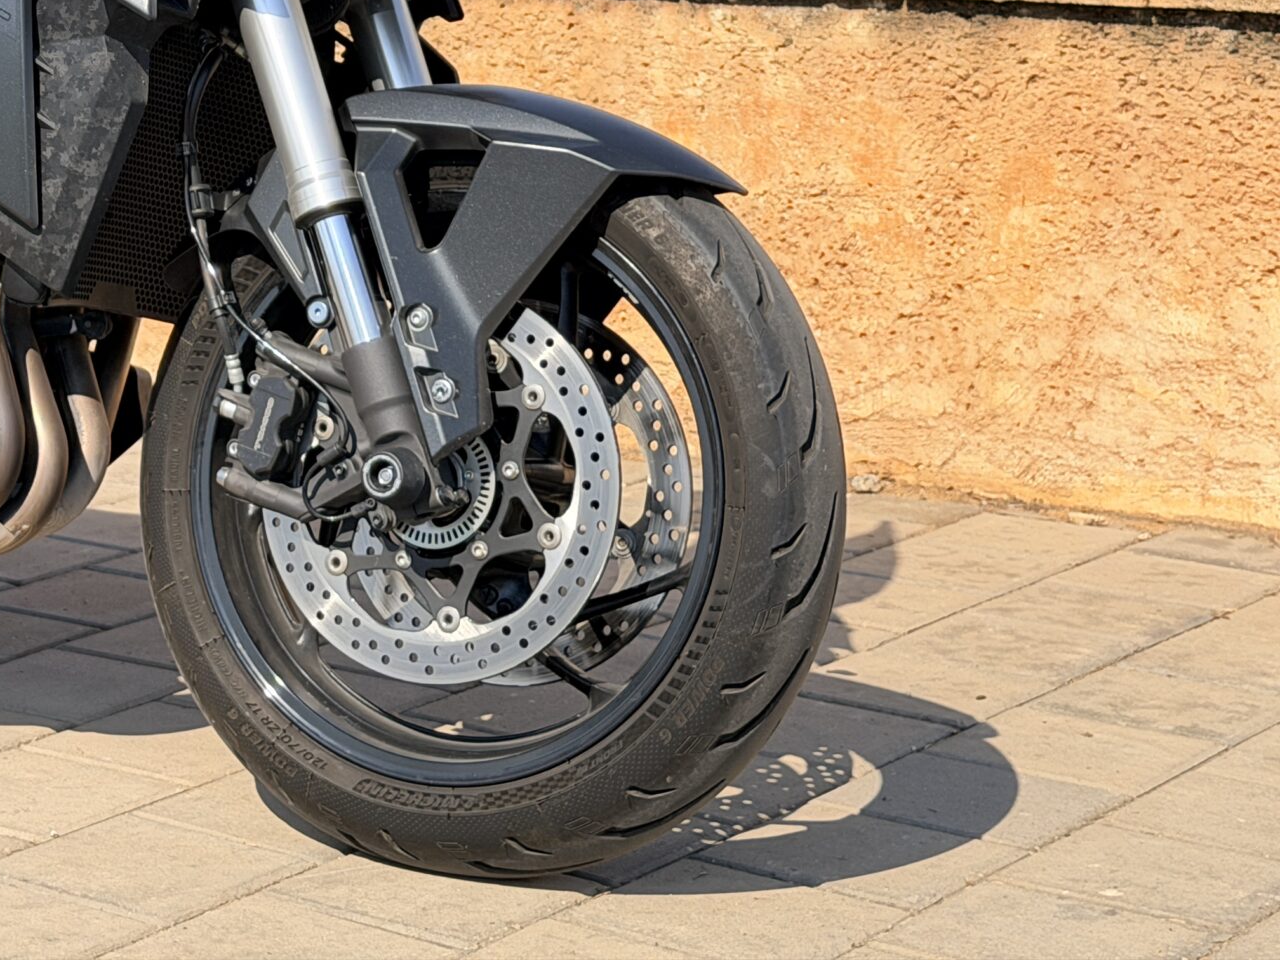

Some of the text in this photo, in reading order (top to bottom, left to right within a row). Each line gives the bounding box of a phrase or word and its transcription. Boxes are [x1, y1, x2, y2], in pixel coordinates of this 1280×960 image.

[245, 702, 329, 770] 120/70 ZR 17
[358, 780, 462, 809] MICHELIN
